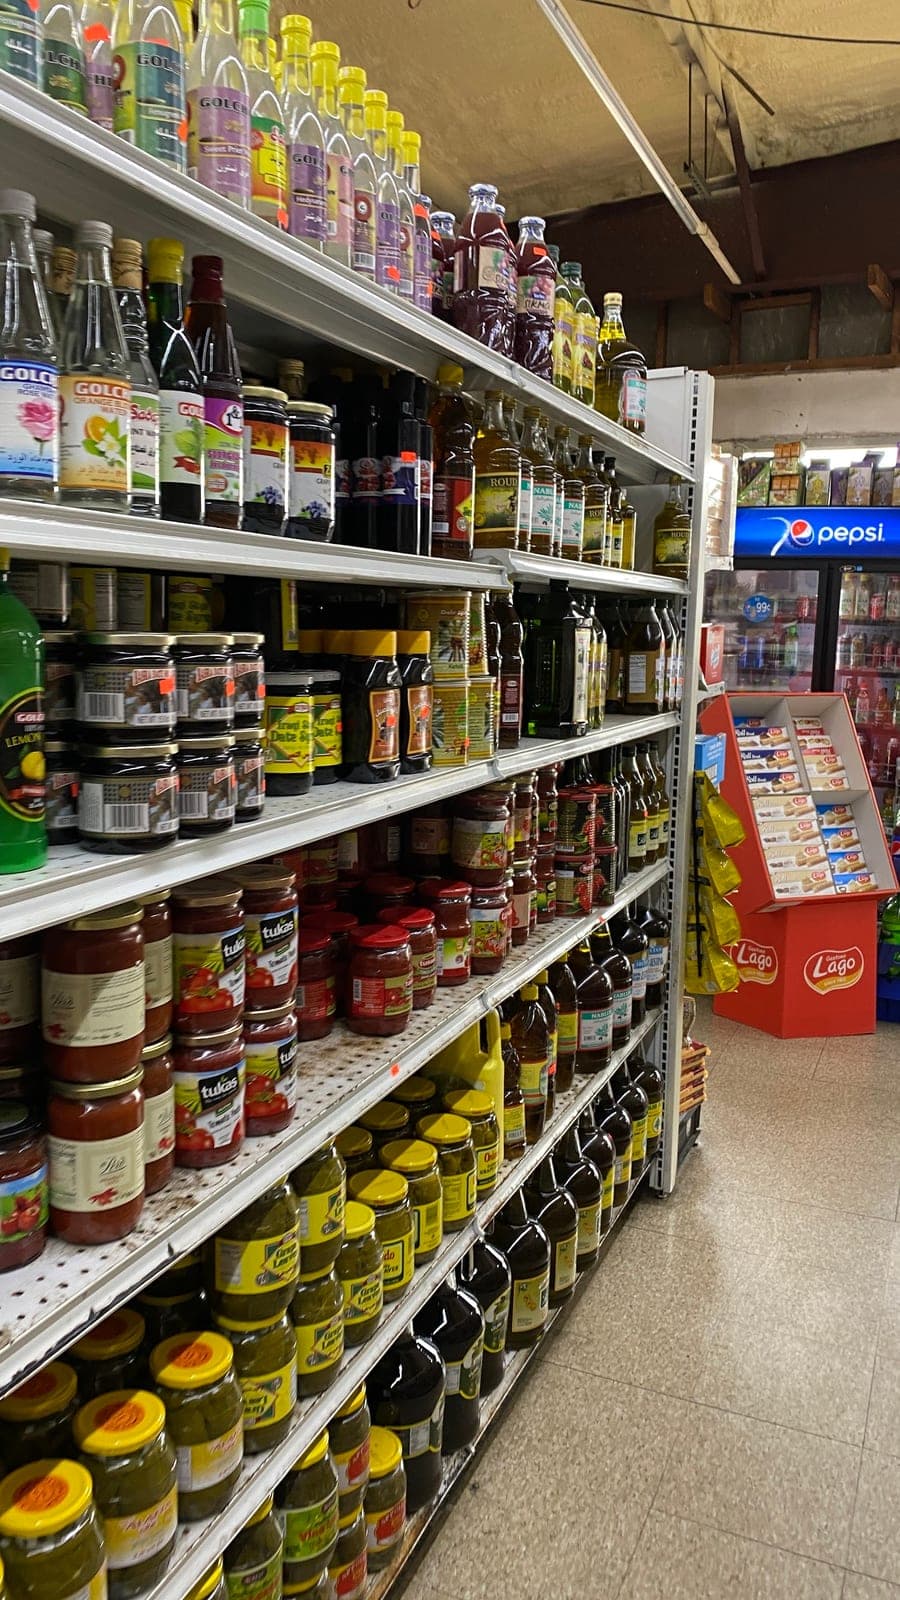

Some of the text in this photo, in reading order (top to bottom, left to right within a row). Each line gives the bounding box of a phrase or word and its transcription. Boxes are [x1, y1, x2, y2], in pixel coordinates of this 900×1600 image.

[818, 523, 884, 546] pepsi
[262, 920, 294, 939] tukas
[736, 943, 773, 971] Lago
[812, 955, 856, 977] Lago
[201, 1077, 238, 1099] tukas
